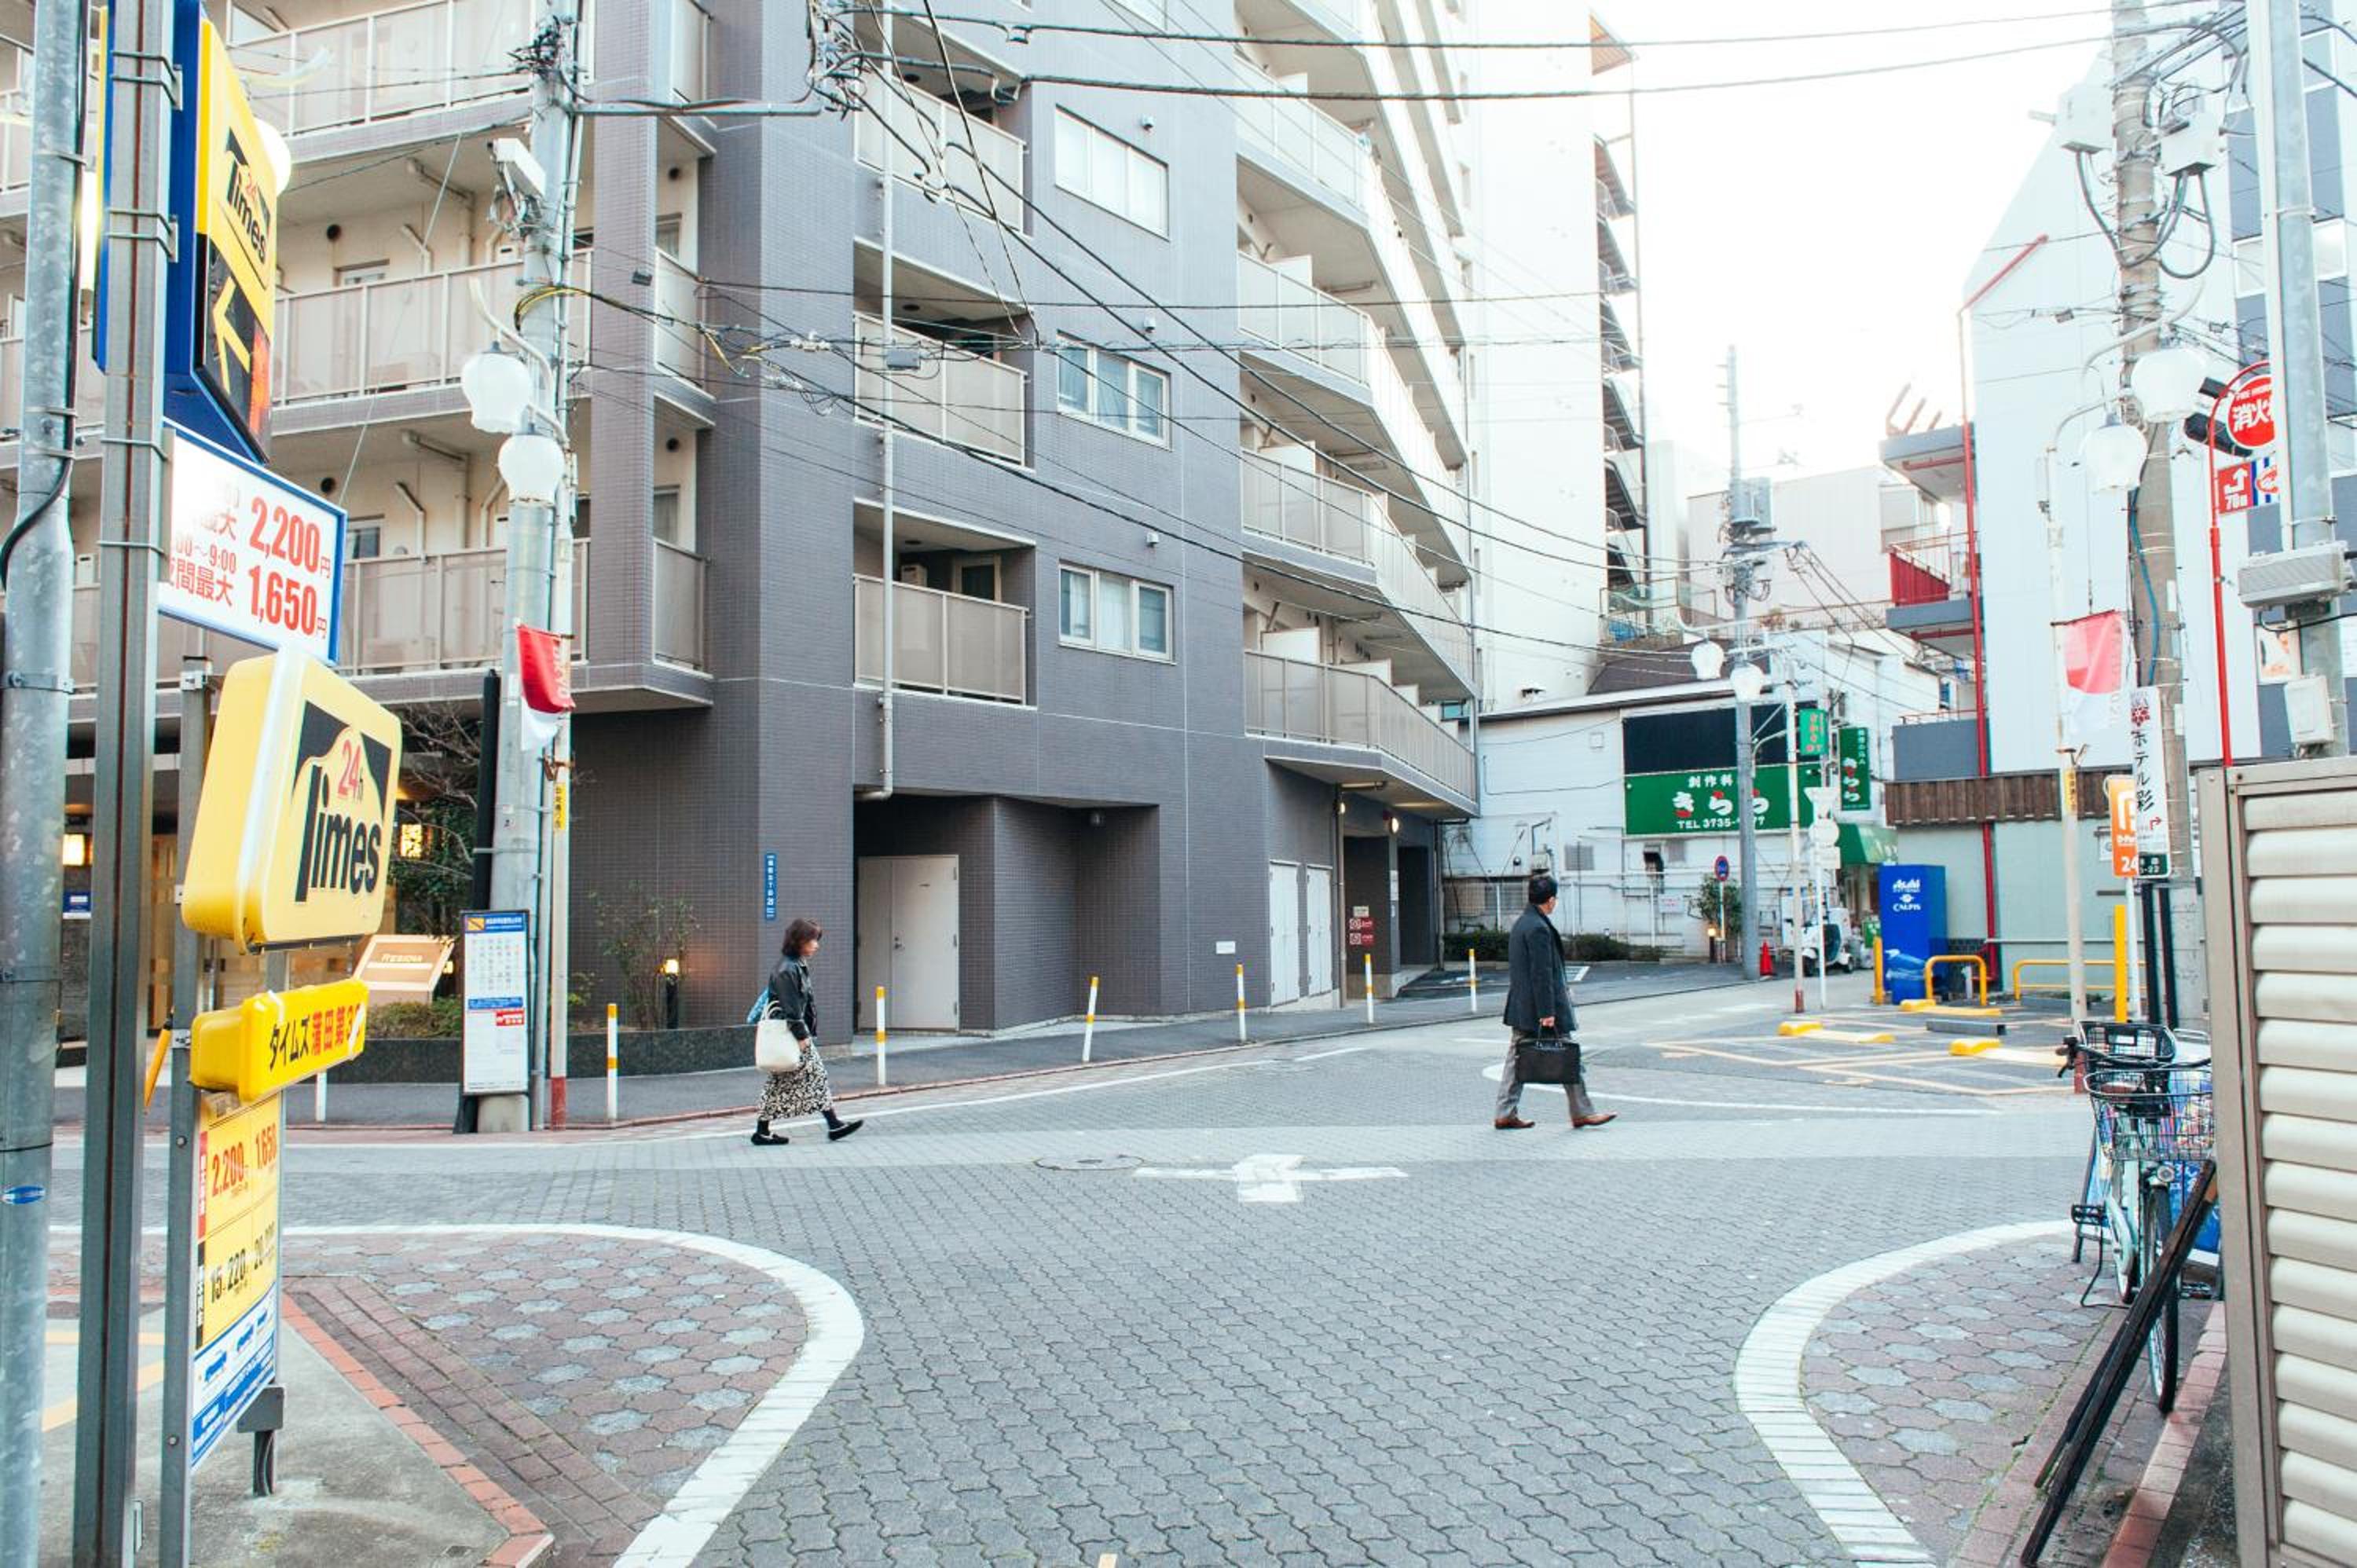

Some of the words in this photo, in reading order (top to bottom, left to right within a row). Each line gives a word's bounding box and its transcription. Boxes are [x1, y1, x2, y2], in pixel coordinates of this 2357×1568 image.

[227, 159, 266, 266] Times
[294, 762, 383, 903] Times
[1676, 819, 1701, 830] TEL
